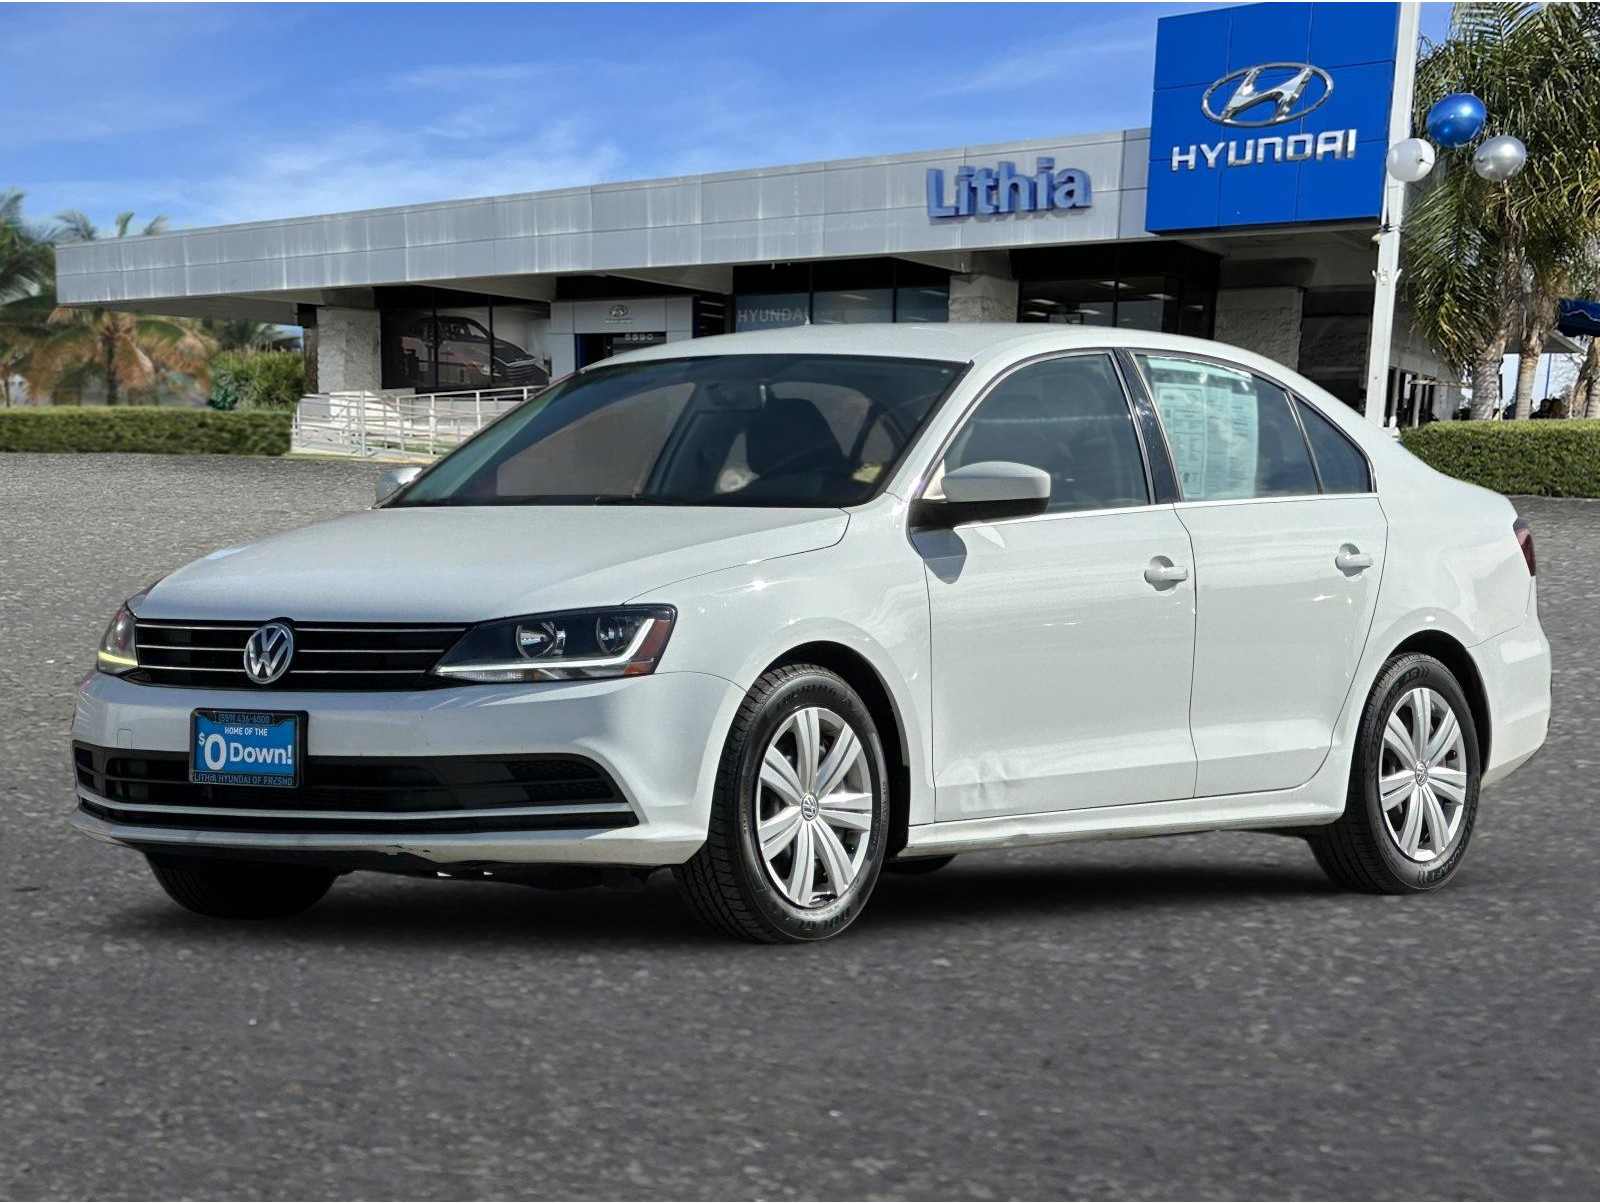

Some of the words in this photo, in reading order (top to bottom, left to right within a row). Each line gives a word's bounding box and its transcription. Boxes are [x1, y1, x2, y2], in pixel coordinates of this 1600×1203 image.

[1171, 129, 1358, 172] HYUNDAI
[926, 157, 1093, 217] Lithia
[224, 726, 243, 736] HOME
[244, 727, 253, 736] OF
[255, 727, 268, 737] THE
[229, 742, 292, 765] Down!
